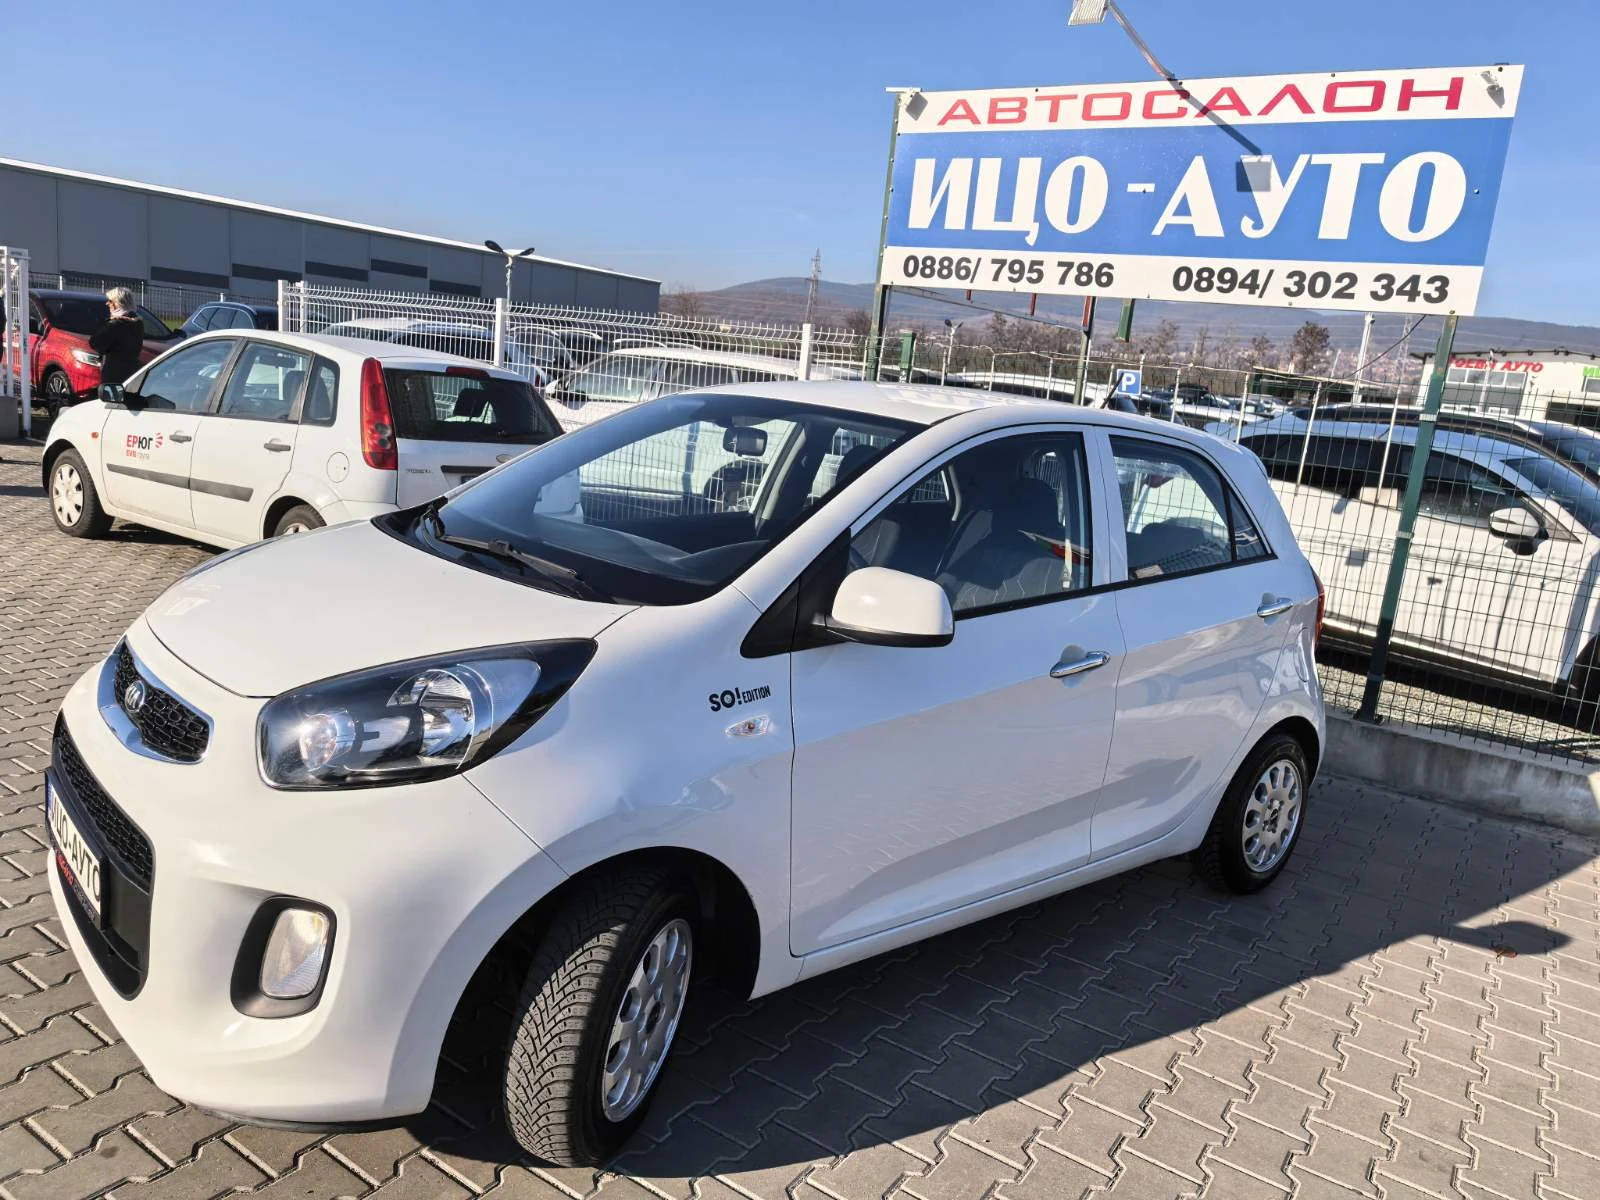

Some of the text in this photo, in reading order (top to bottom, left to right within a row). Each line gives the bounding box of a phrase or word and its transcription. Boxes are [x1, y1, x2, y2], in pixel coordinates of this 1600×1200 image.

[938, 76, 1465, 126] АВТОСАЛОН
[902, 254, 1115, 288] 0886/ 795 786
[1172, 266, 1451, 303] 0894/ 302 343
[742, 685, 771, 704] EDITION
